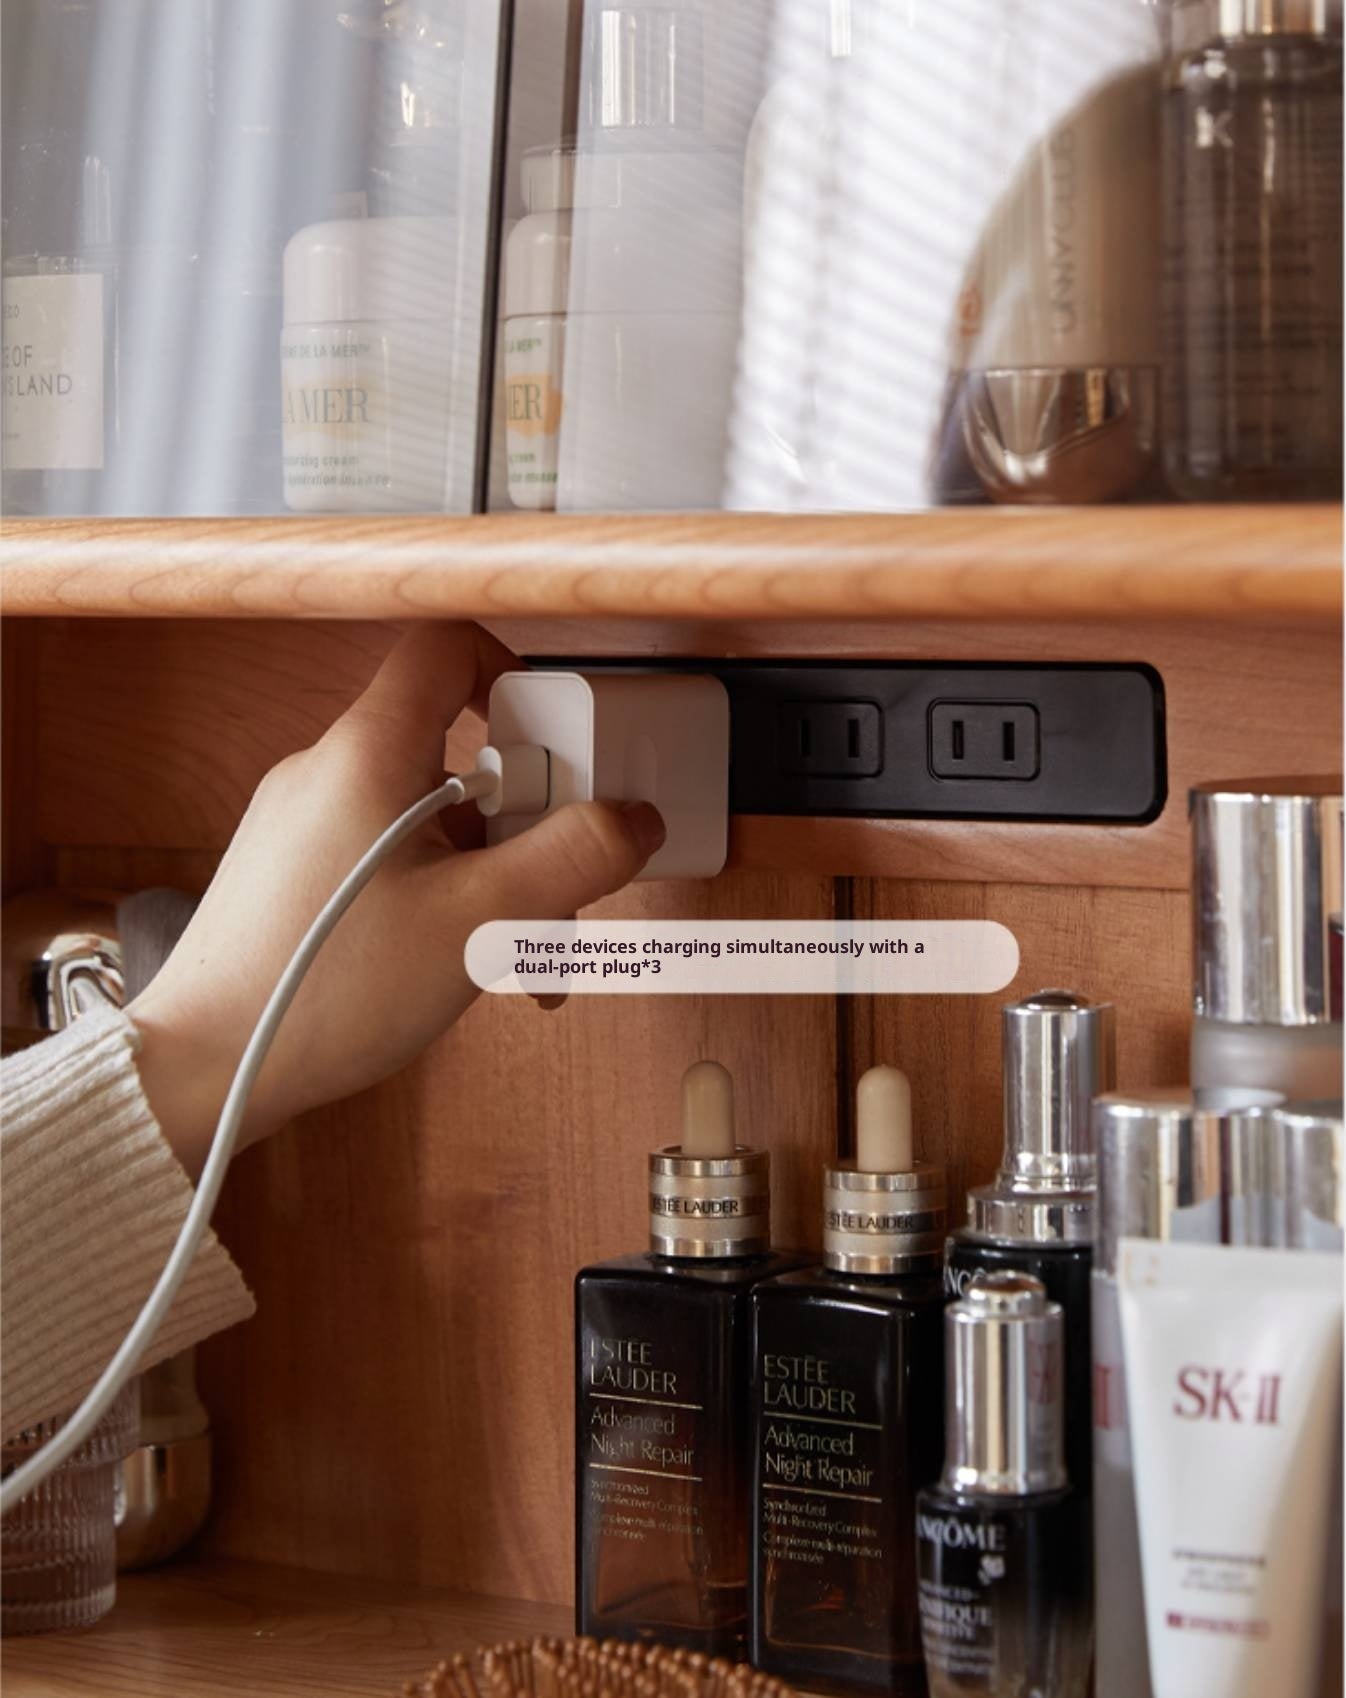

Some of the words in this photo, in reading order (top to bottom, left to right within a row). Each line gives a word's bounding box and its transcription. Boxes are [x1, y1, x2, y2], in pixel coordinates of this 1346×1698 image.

[4, 374, 73, 397] SLAND
[297, 387, 371, 424] MER
[684, 1199, 739, 1214] LAUDER
[857, 1214, 914, 1229] LAUDER
[589, 1363, 677, 1395] LAUDER
[1172, 1363, 1282, 1425] SK-II
[763, 1380, 856, 1415] LAUDER
[590, 1405, 676, 1436] Advanced
[590, 1432, 635, 1460] Night
[640, 1438, 695, 1469] Repair
[763, 1423, 855, 1456] Advanced
[764, 1450, 813, 1483] Night
[817, 1456, 874, 1489] Repair
